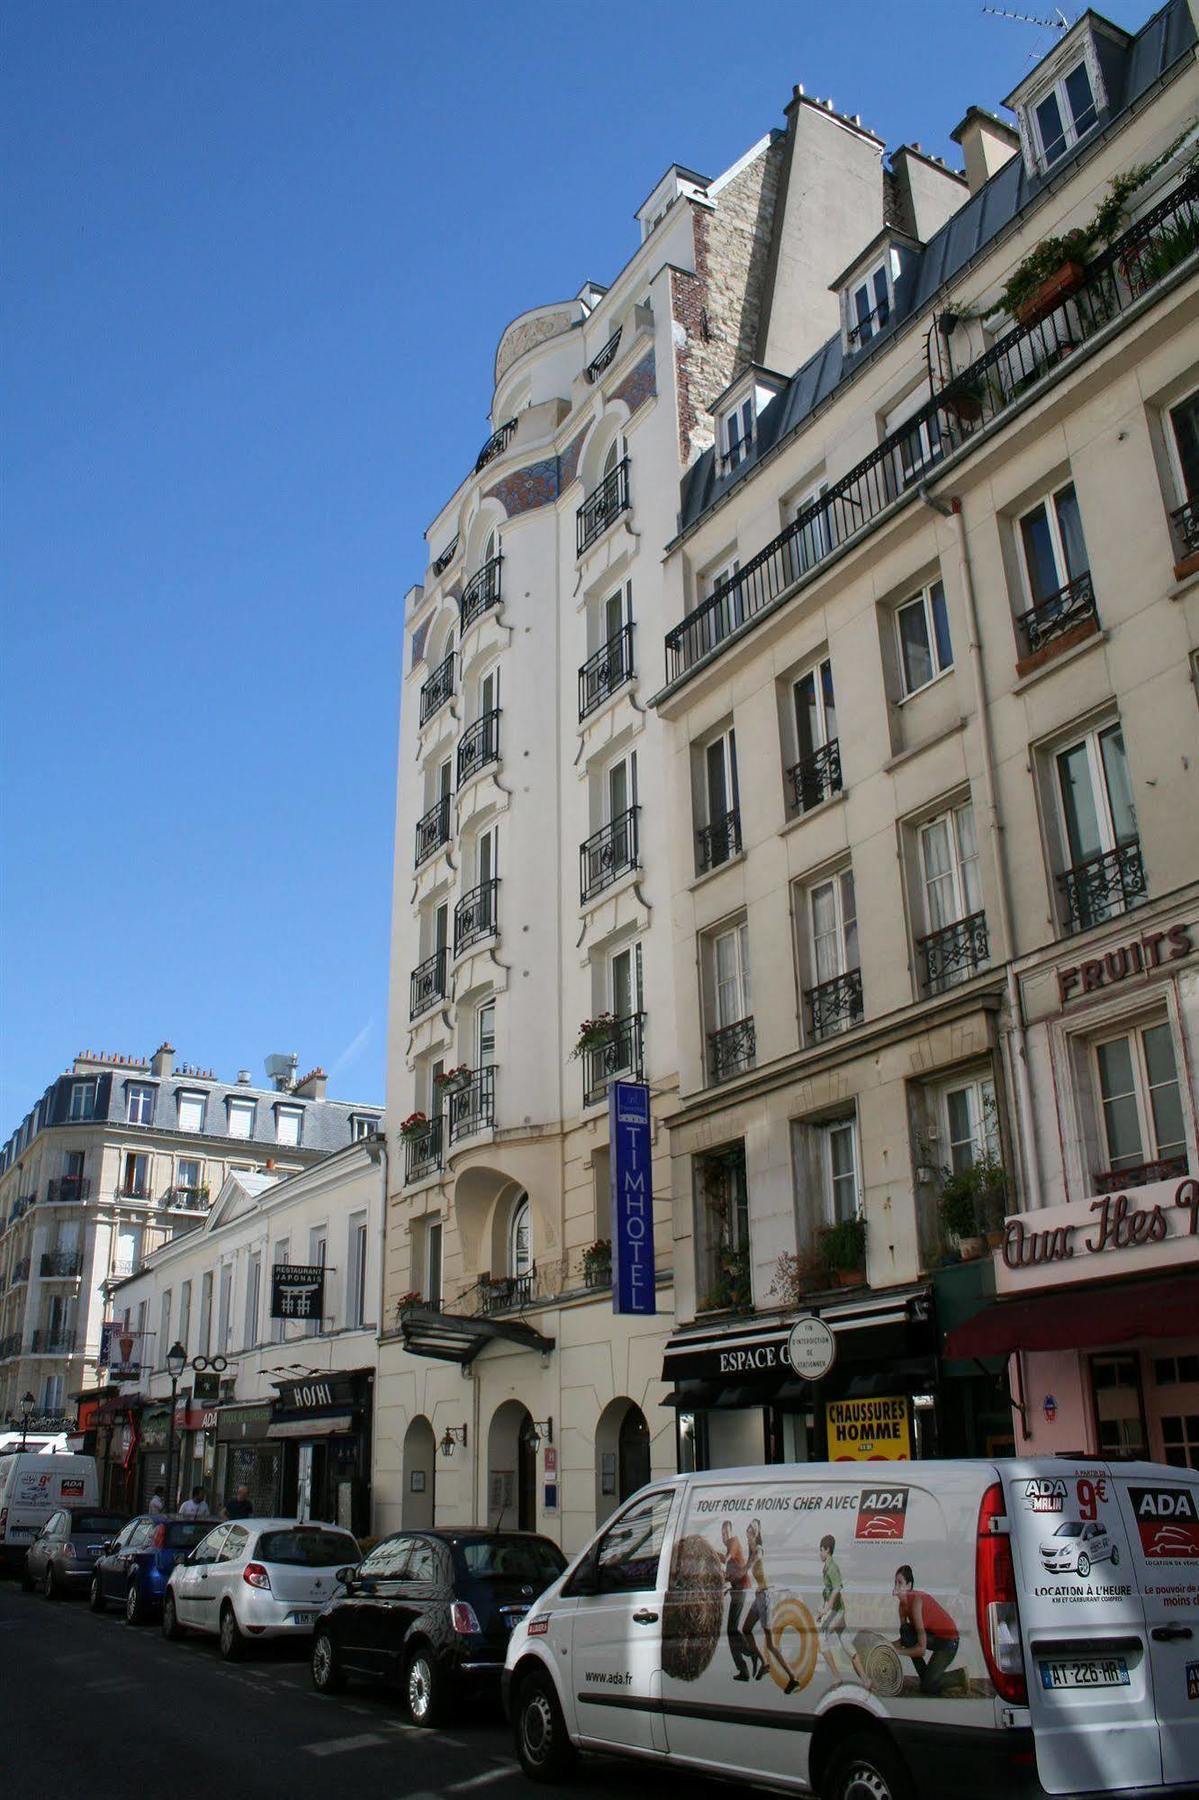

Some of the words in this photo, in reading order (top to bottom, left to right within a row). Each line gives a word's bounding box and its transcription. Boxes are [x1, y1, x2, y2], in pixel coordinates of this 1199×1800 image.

[1059, 923, 1191, 1001] FRUITS
[624, 1126, 645, 1310] TIMHOTEL
[1002, 1219, 1075, 1269] Aux
[274, 1274, 322, 1282] JAPONAIS
[275, 1266, 322, 1275] RESTAURANT
[720, 1346, 777, 1373] ESPACE
[294, 1383, 332, 1407] HOSHI
[201, 1412, 217, 1427] ADA
[829, 1400, 906, 1423] CHAUSSURES
[836, 1421, 902, 1442] HOMME
[1026, 1479, 1068, 1497] ADA
[697, 1500, 720, 1513] TOUT
[721, 1498, 753, 1512] ROULE
[754, 1497, 790, 1511] MOINS
[793, 1496, 823, 1510] CHER
[824, 1495, 858, 1510] AVEC
[862, 1493, 905, 1509] ADA
[1032, 1497, 1063, 1512] MALIN
[1139, 1494, 1192, 1516] ADA
[1035, 1586, 1083, 1597] LOCATION
[1087, 1583, 1093, 1596] À
[1095, 1585, 1132, 1596] L'HEURE
[1144, 1585, 1154, 1595] Le
[1155, 1584, 1185, 1595] pouvoir
[1187, 1583, 1196, 1593] de
[1163, 1595, 1191, 1606] moins
[585, 1671, 633, 1685] www.ada.fr
